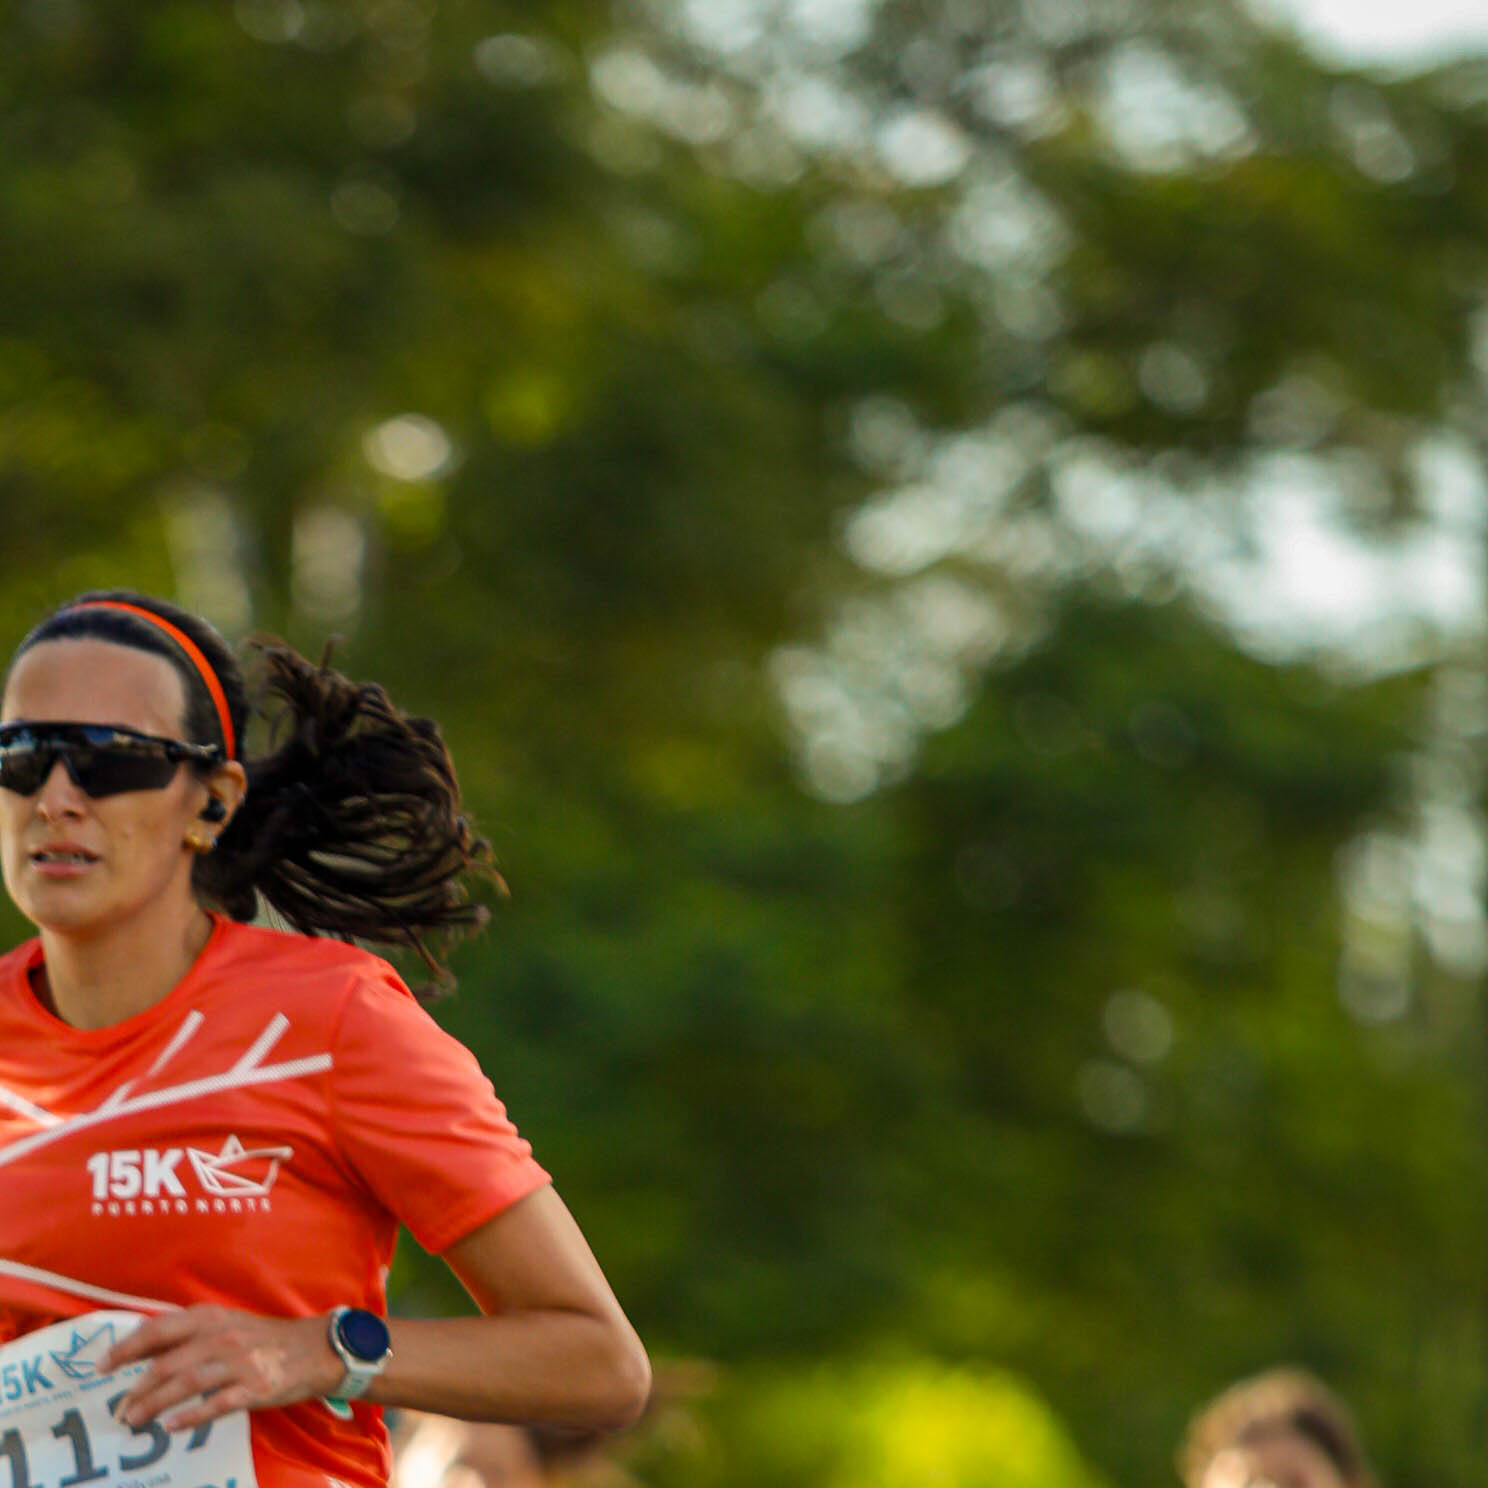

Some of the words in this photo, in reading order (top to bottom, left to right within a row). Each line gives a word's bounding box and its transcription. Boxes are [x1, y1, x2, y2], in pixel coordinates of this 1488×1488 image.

[87, 1148, 186, 1200] 15K
[91, 1200, 188, 1217] PUERTO
[196, 1198, 272, 1214] NORTE
